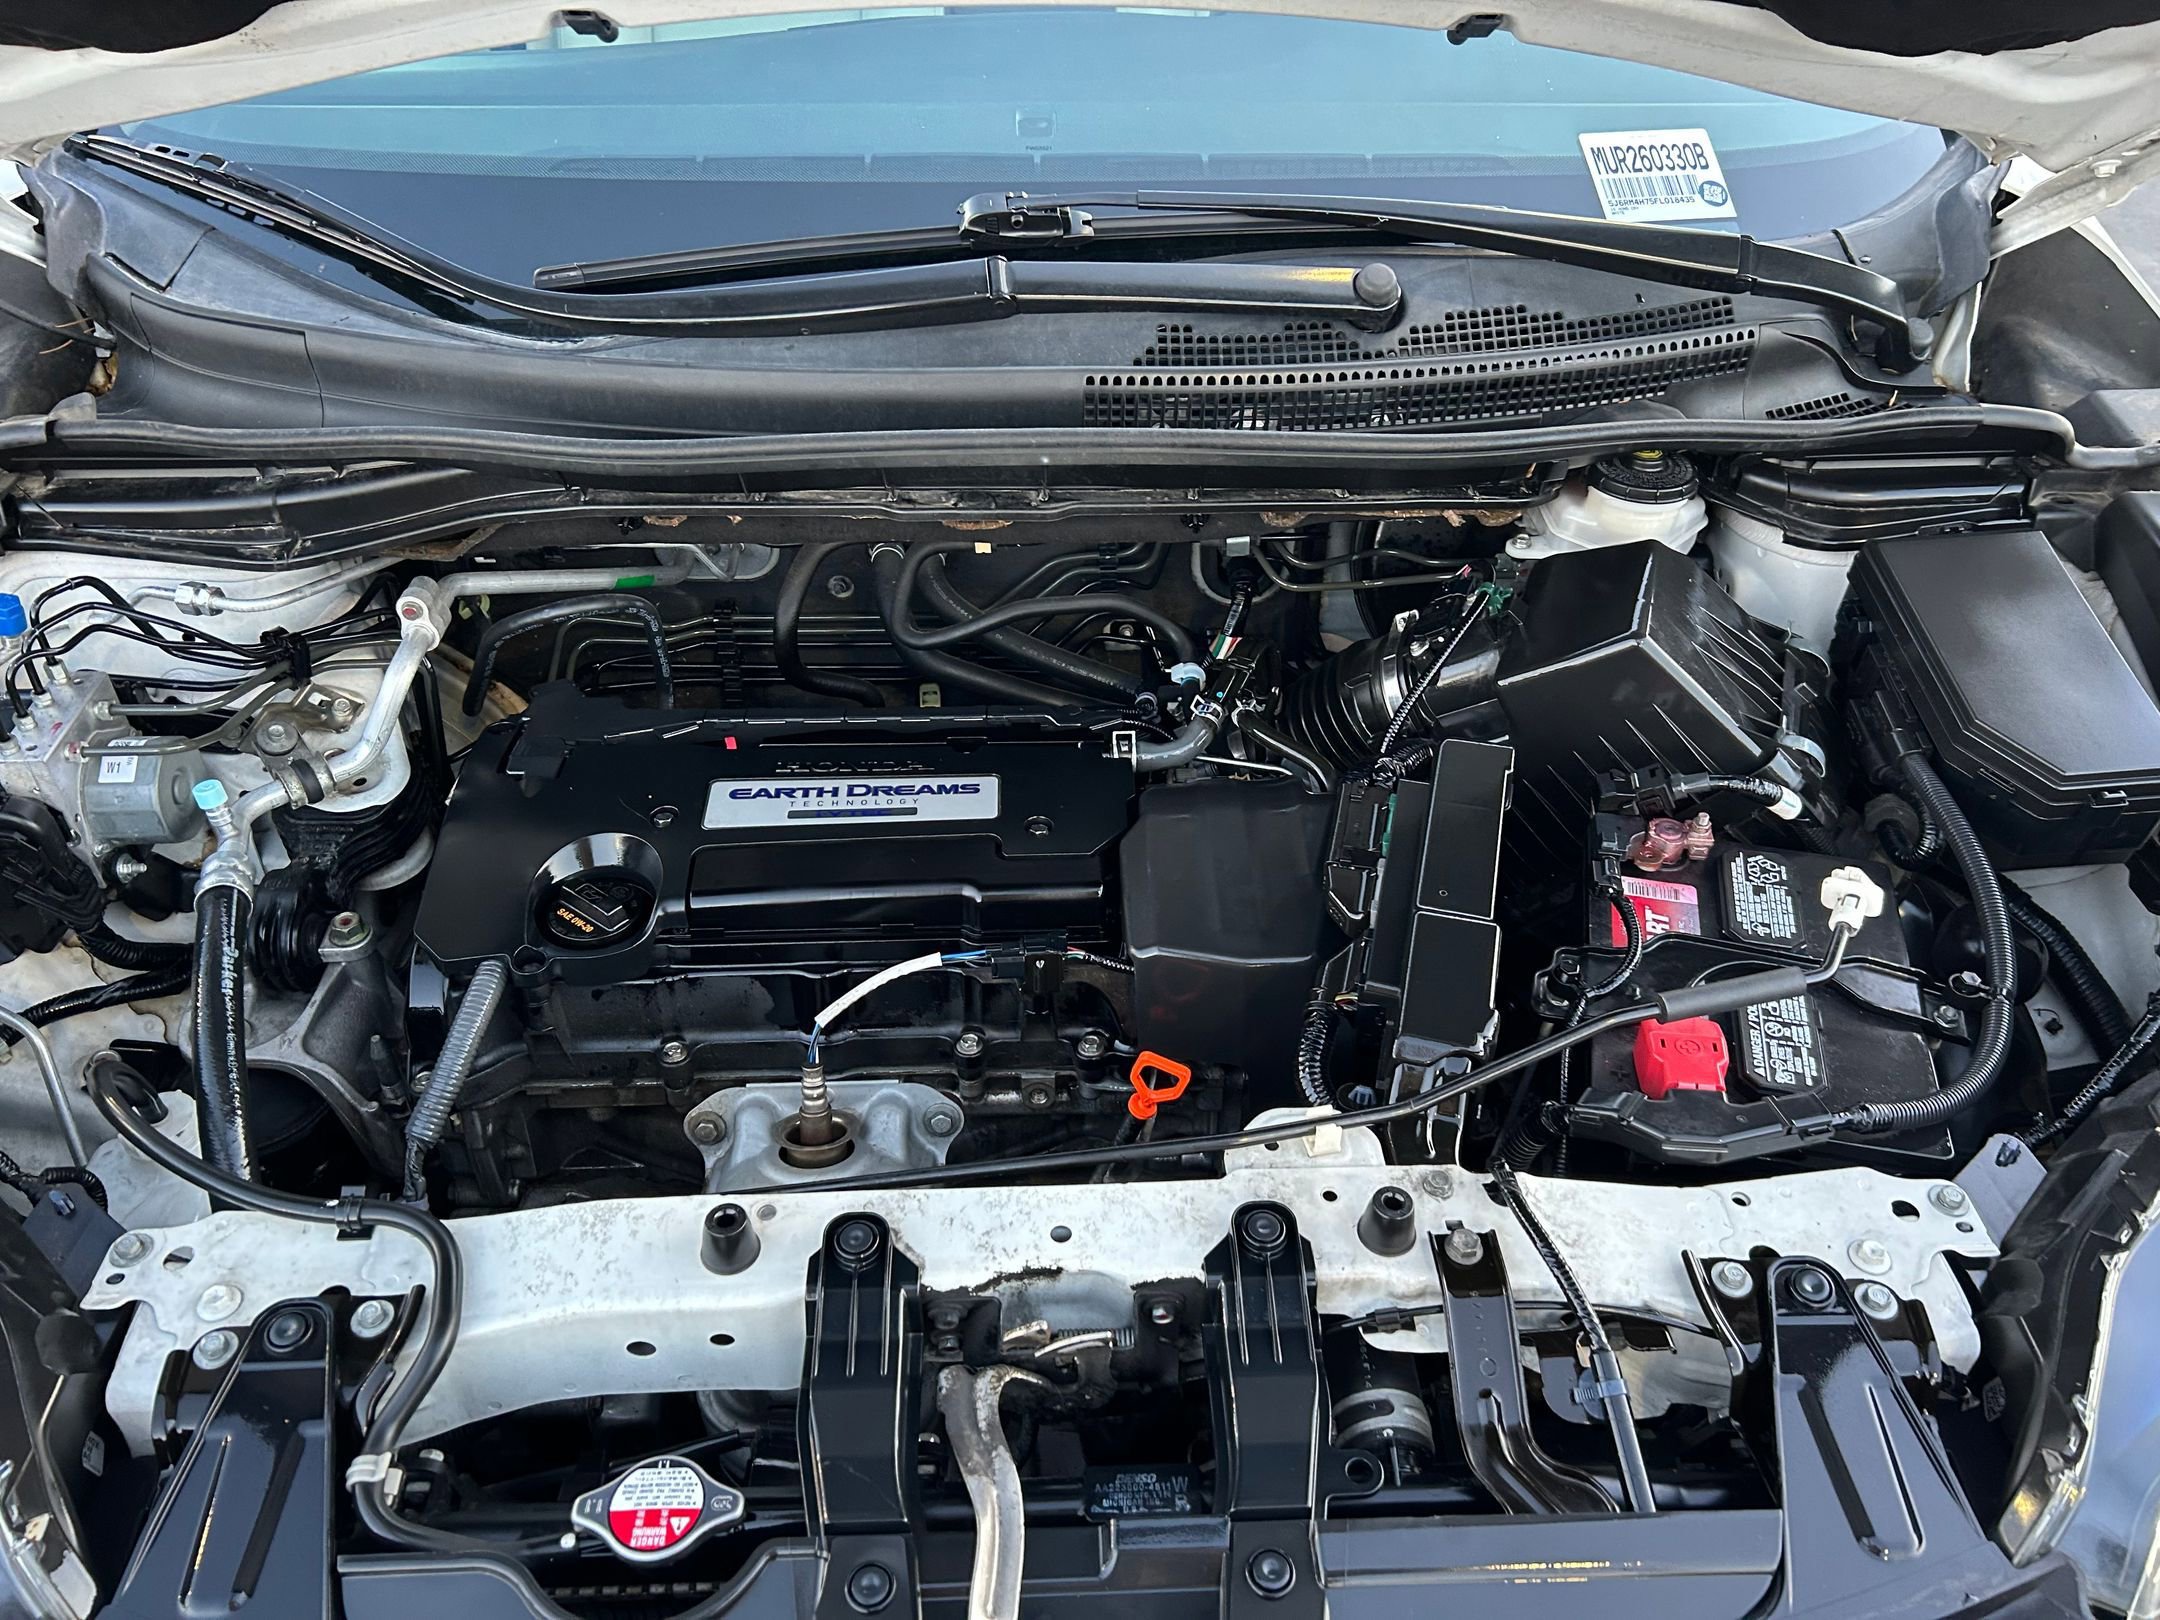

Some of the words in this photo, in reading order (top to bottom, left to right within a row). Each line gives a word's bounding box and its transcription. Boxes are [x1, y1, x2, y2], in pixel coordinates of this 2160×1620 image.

[1590, 142, 1709, 175] MUR260330B
[1607, 196, 1696, 207] 5J6RM4H75FL018435
[107, 762, 121, 773] W1
[775, 760, 935, 773] HONDA
[728, 784, 840, 800] EARTH
[846, 783, 980, 798] DREAMS
[789, 798, 919, 807] TECHNOLOGY
[557, 908, 575, 920] SAE
[570, 916, 595, 933] 0W-20
[221, 945, 239, 994] Parker
[1749, 1028, 1764, 1067] DANGER
[630, 1536, 666, 1547] DANGER
